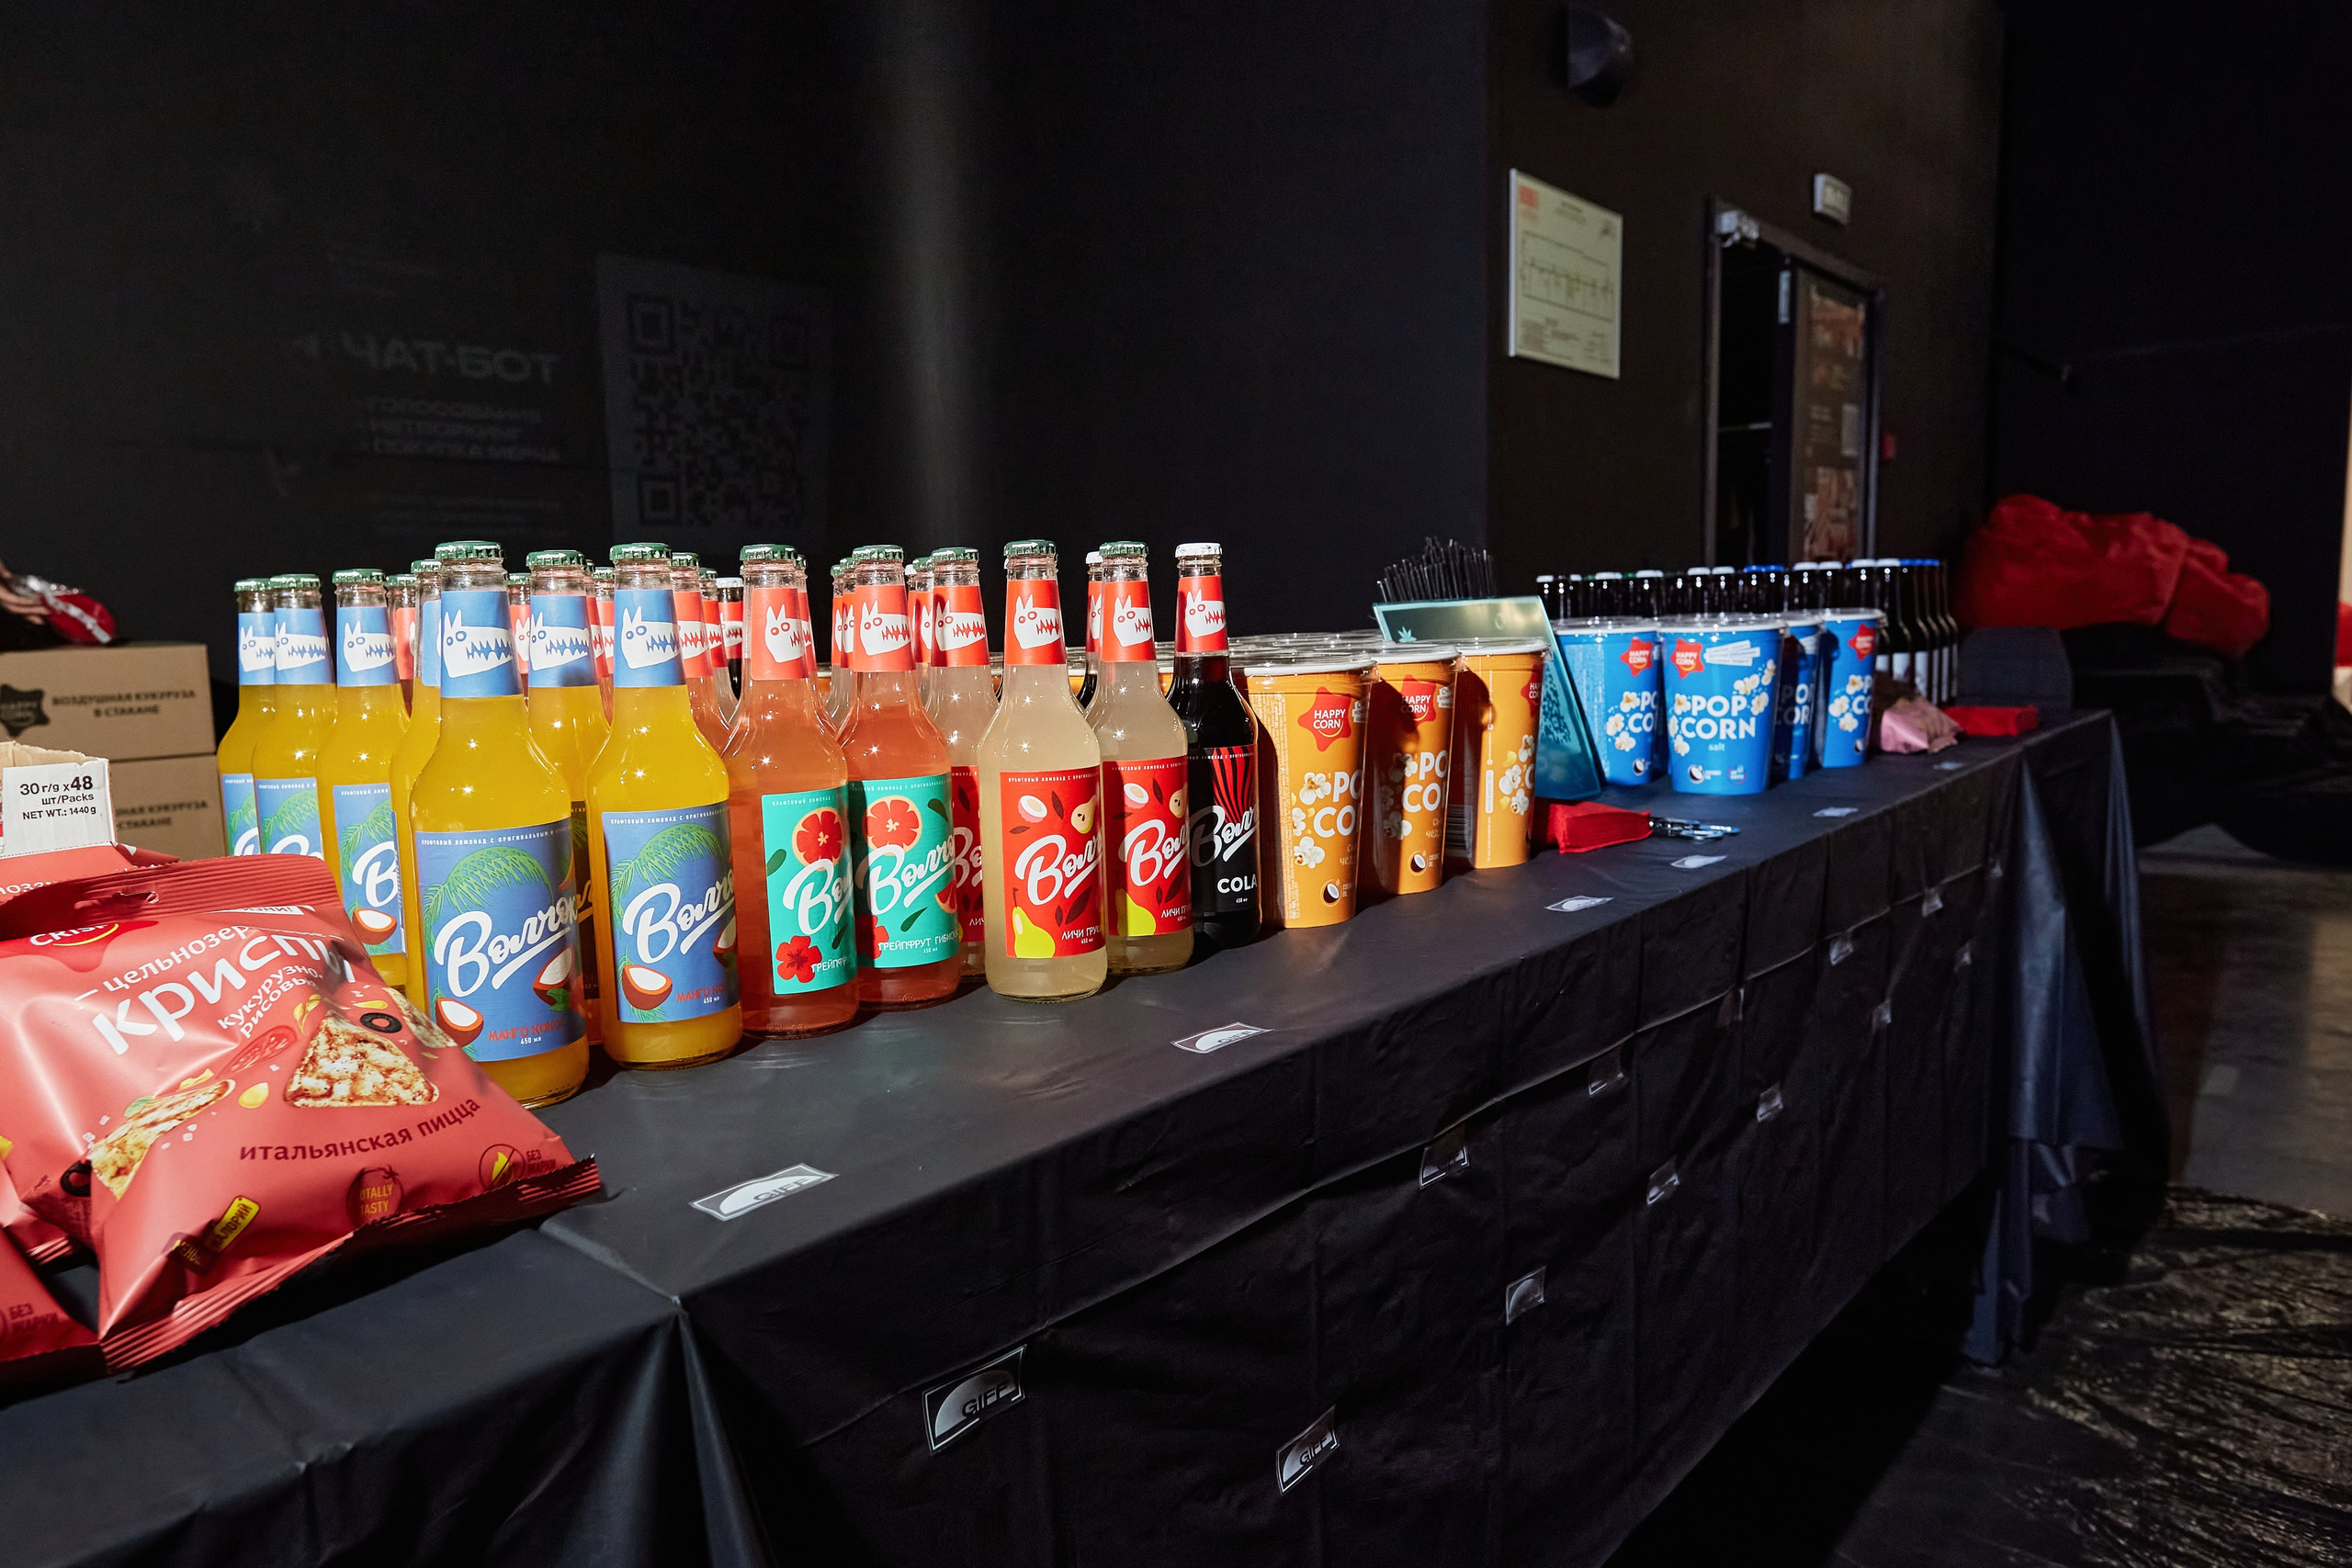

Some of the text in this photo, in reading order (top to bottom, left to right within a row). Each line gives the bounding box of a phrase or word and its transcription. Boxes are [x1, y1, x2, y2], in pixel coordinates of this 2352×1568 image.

[340, 331, 561, 384] ЧАТ-БОТ
[135, 690, 197, 701] КУКУРУЗА
[1402, 694, 1431, 705] HAPPY
[94, 705, 160, 717] В СТАКАНЕ
[1401, 704, 1427, 714] CORN
[1691, 694, 1747, 716] POP
[1314, 709, 1346, 720] HAPPY
[1313, 718, 1341, 729] CORN
[1627, 712, 1655, 733] CO
[1680, 717, 1756, 740] CORN
[1419, 750, 1448, 781] PO
[20, 783, 40, 795] 30
[1332, 769, 1363, 803] PO
[41, 793, 95, 806] шт/Packs
[772, 797, 807, 807] КРАФТОВЫЙ
[1402, 783, 1443, 813] CO
[23, 810, 43, 820] NET
[69, 806, 89, 816] 1440
[1313, 806, 1357, 839] CO
[1217, 874, 1258, 894] COLA
[1161, 908, 1181, 918] ЛИЧИ
[1061, 929, 1084, 940] ЛИЧИ
[877, 937, 932, 952] ГРЕЙПФРУТ
[103, 925, 249, 992] цельнозер
[676, 987, 711, 1003] МАНГО
[703, 996, 713, 1004] 450
[489, 1026, 529, 1042] МАНГО
[239, 1097, 482, 1163] итальянская пицца
[526, 1149, 541, 1161] БЕЗ
[962, 1380, 1008, 1417] GIFF
